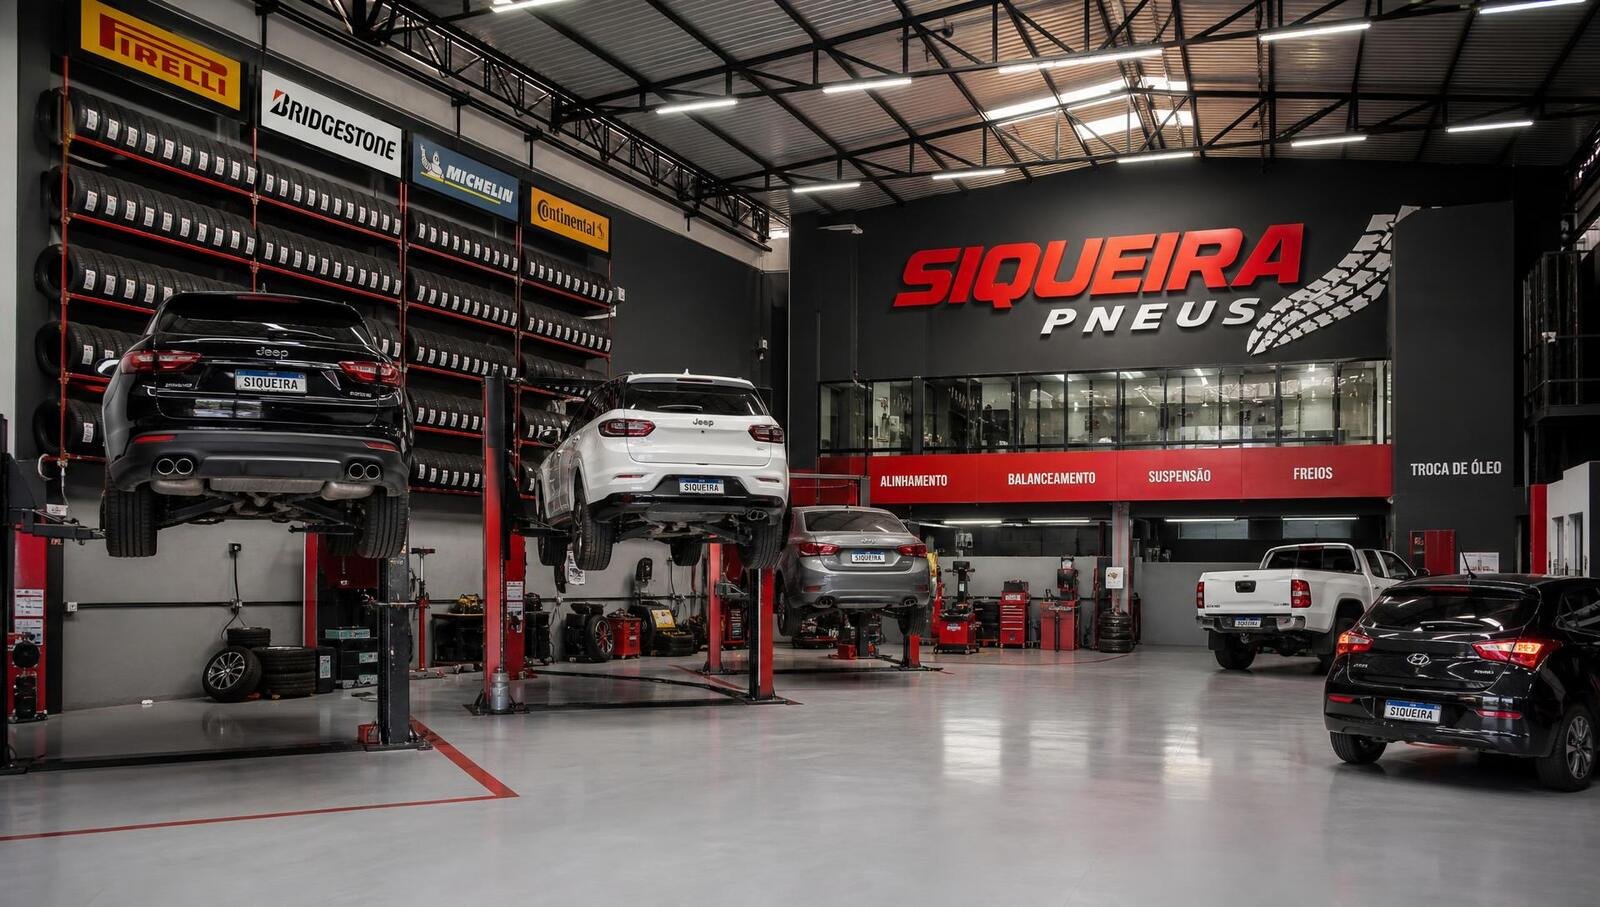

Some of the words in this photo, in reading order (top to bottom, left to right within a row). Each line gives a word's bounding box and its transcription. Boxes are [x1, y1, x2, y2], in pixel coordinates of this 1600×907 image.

[100, 13, 228, 97] PIRELLI
[270, 89, 397, 161] BRIDGESTONE
[446, 164, 514, 204] MICHELIN
[537, 199, 596, 237] Continental
[893, 223, 1304, 309] SIQUEIRA
[1040, 297, 1260, 336] PNEUS
[256, 346, 289, 360] Jeep
[244, 377, 298, 391] SIQUEIRA
[692, 418, 714, 427] Jeep
[1293, 466, 1333, 480] FREIOS
[1410, 462, 1449, 476] TROCA
[1452, 462, 1468, 475] DE
[1471, 458, 1502, 475] ÓLEO
[880, 474, 948, 487] ALINHAMENTO
[1008, 471, 1096, 486] BALANCEAMENTO
[1148, 468, 1211, 483] SUSPENSÃO
[684, 483, 719, 492] SIQUEIRA
[1390, 706, 1433, 720] SIQUEIRA
